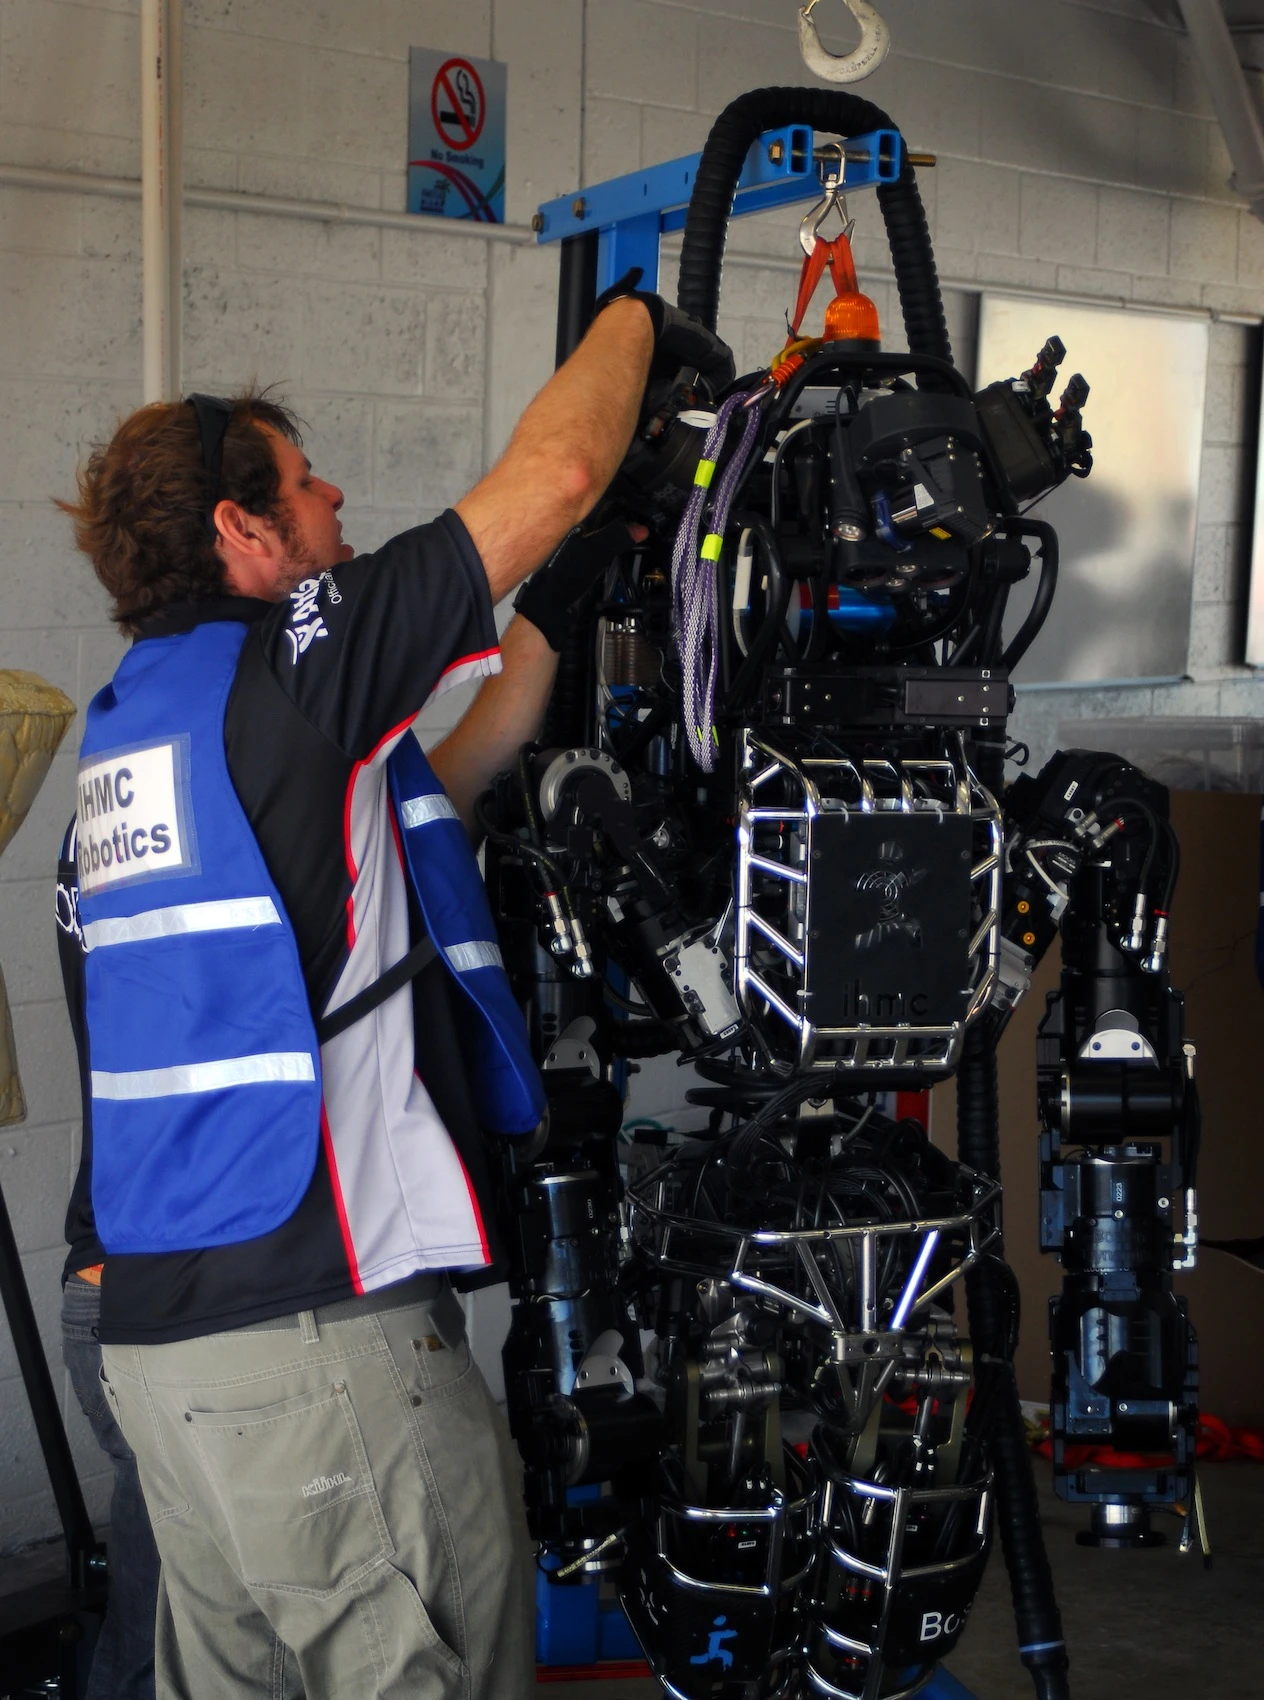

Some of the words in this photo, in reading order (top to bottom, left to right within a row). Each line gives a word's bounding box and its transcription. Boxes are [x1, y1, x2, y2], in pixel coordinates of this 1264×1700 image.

[431, 149, 443, 160] No
[446, 150, 484, 169] Smoking
[80, 767, 134, 824] IHMC
[77, 822, 172, 879] Robotics
[843, 978, 929, 1018] ihmc
